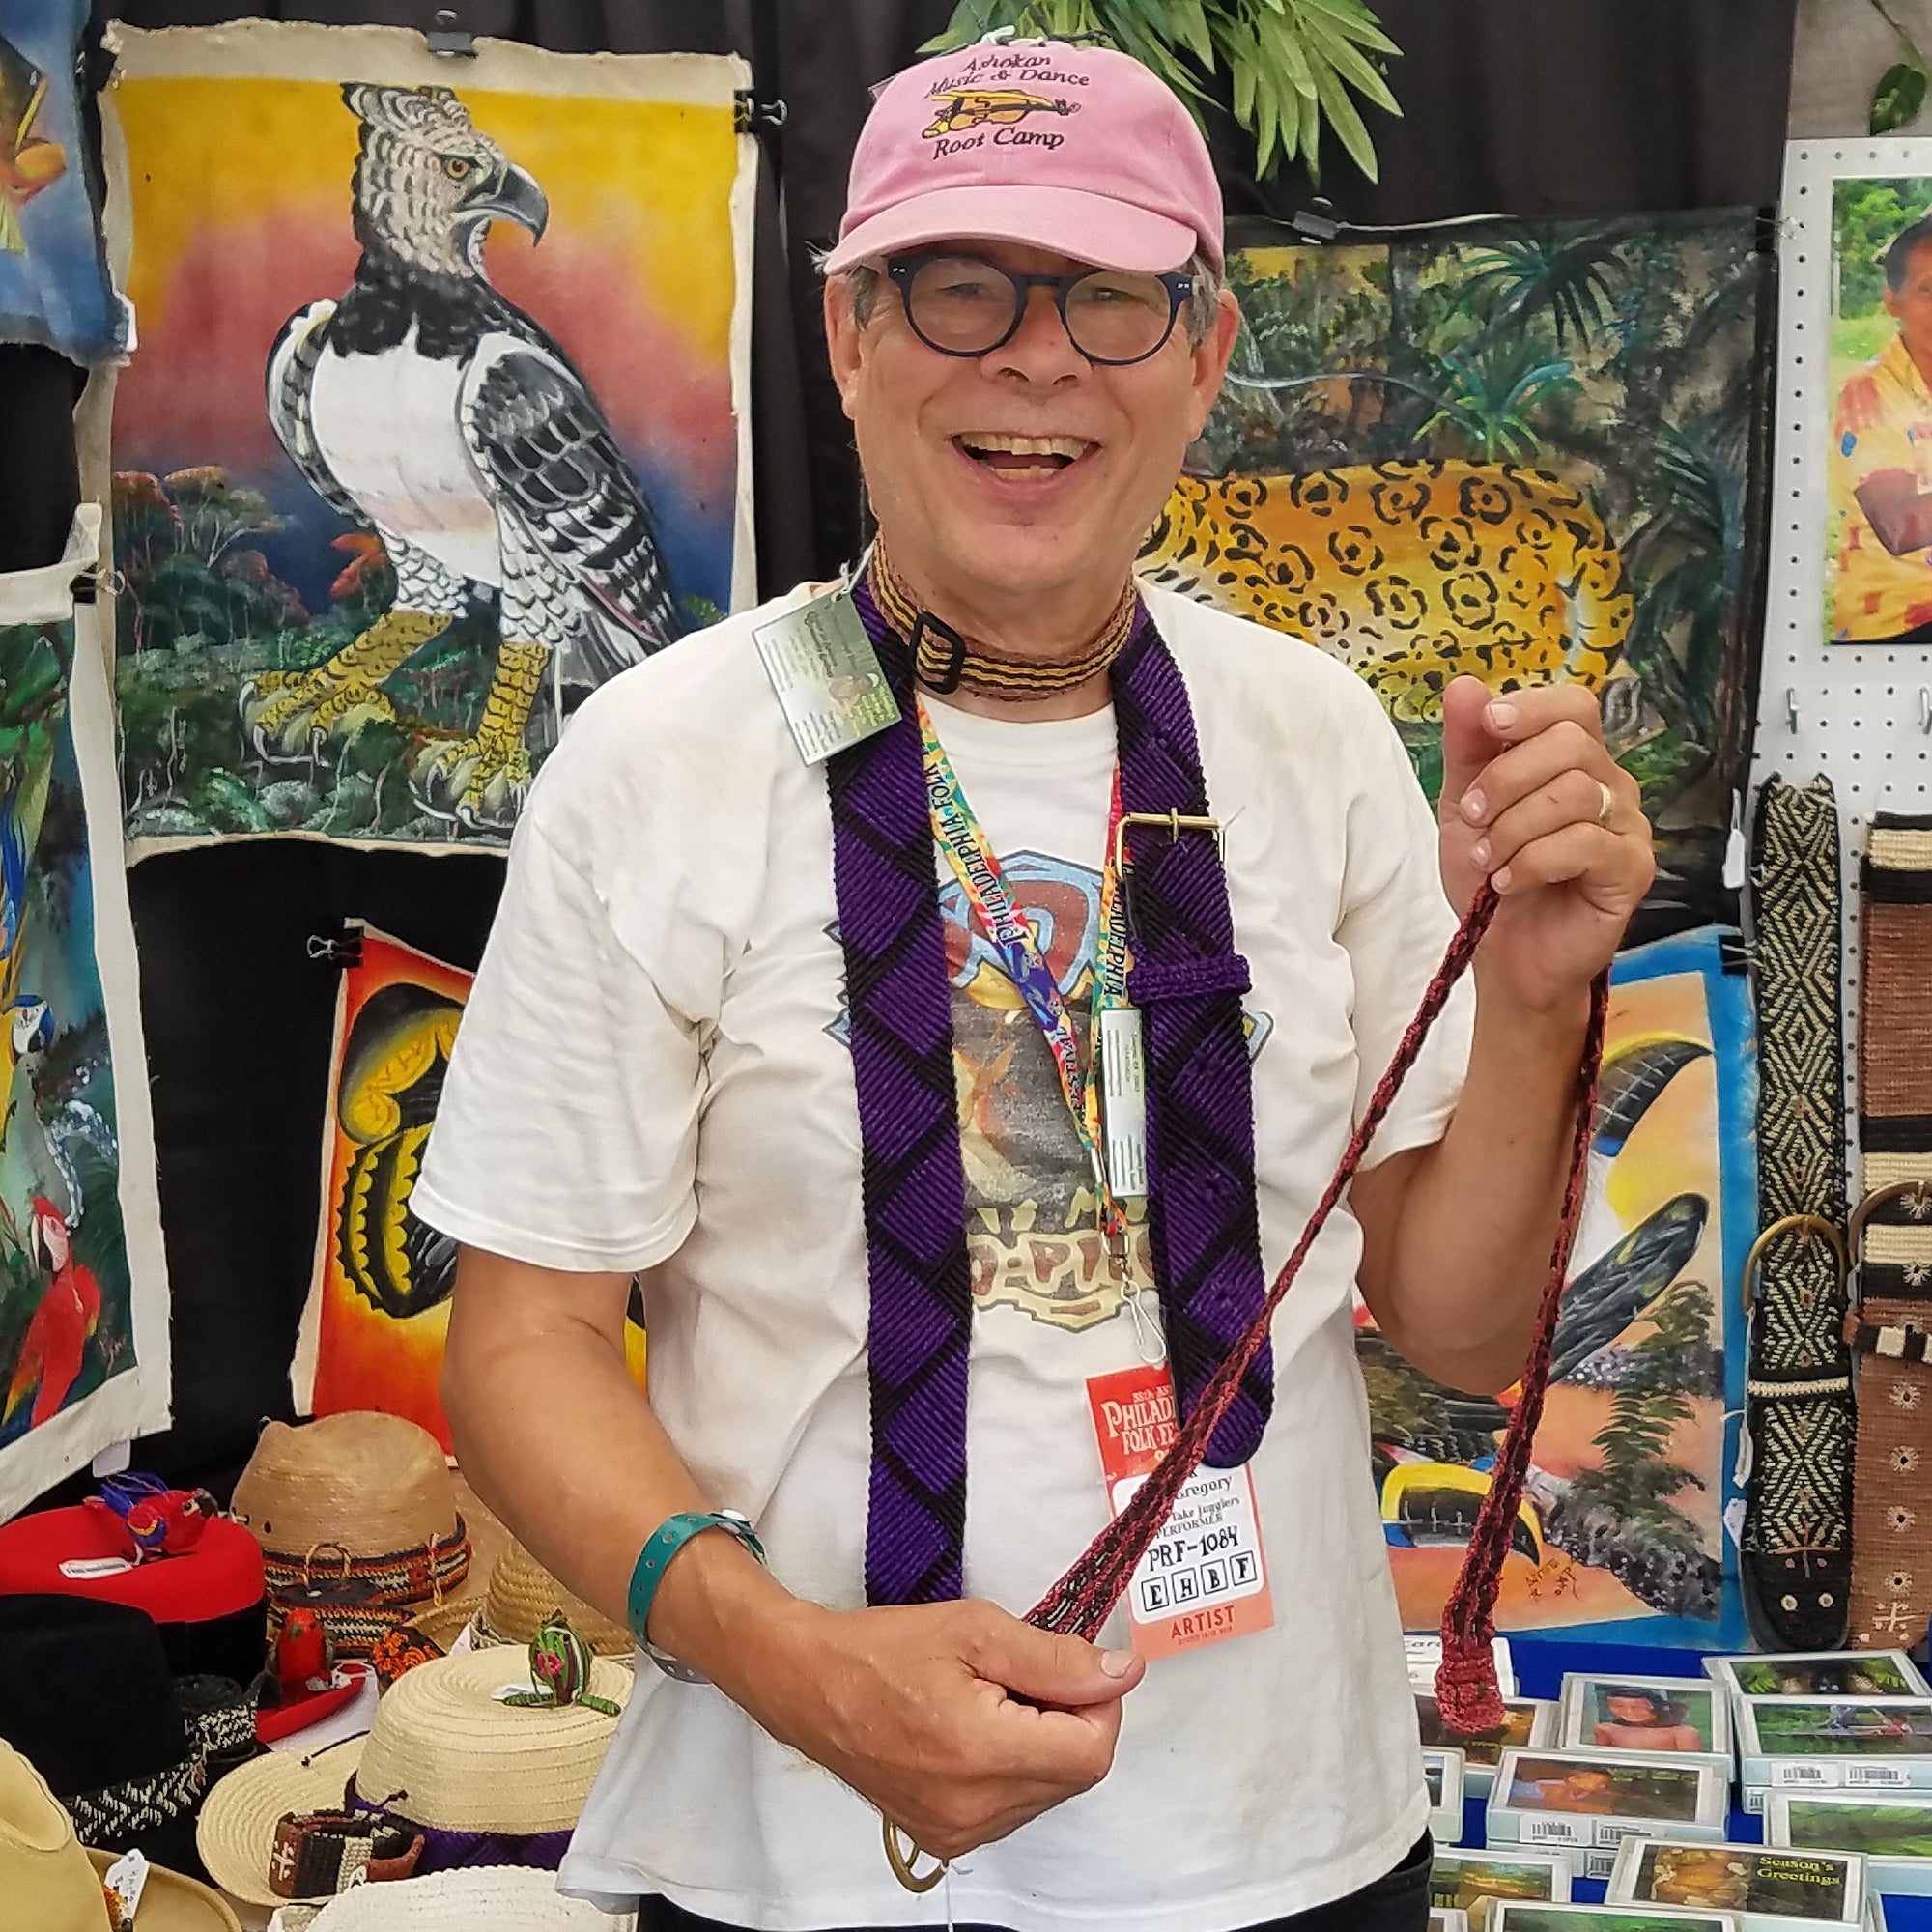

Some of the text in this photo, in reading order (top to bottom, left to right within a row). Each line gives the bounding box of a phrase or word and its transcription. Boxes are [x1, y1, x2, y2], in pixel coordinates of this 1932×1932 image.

[924, 69, 1090, 99] Music & Dance
[932, 126, 1065, 160] Root Camp
[940, 812, 1029, 947] PHILADELPHIA
[1100, 1396, 1177, 1438] PHILAD
[1121, 1425, 1158, 1455] FOLK
[1148, 1524, 1239, 1573] PRF-1084
[1151, 1556, 1250, 1607] E H B F
[1171, 1605, 1236, 1639] ARTIST
[1756, 1868, 1840, 1887] Greetings
[1759, 1855, 1834, 1873] Season's
